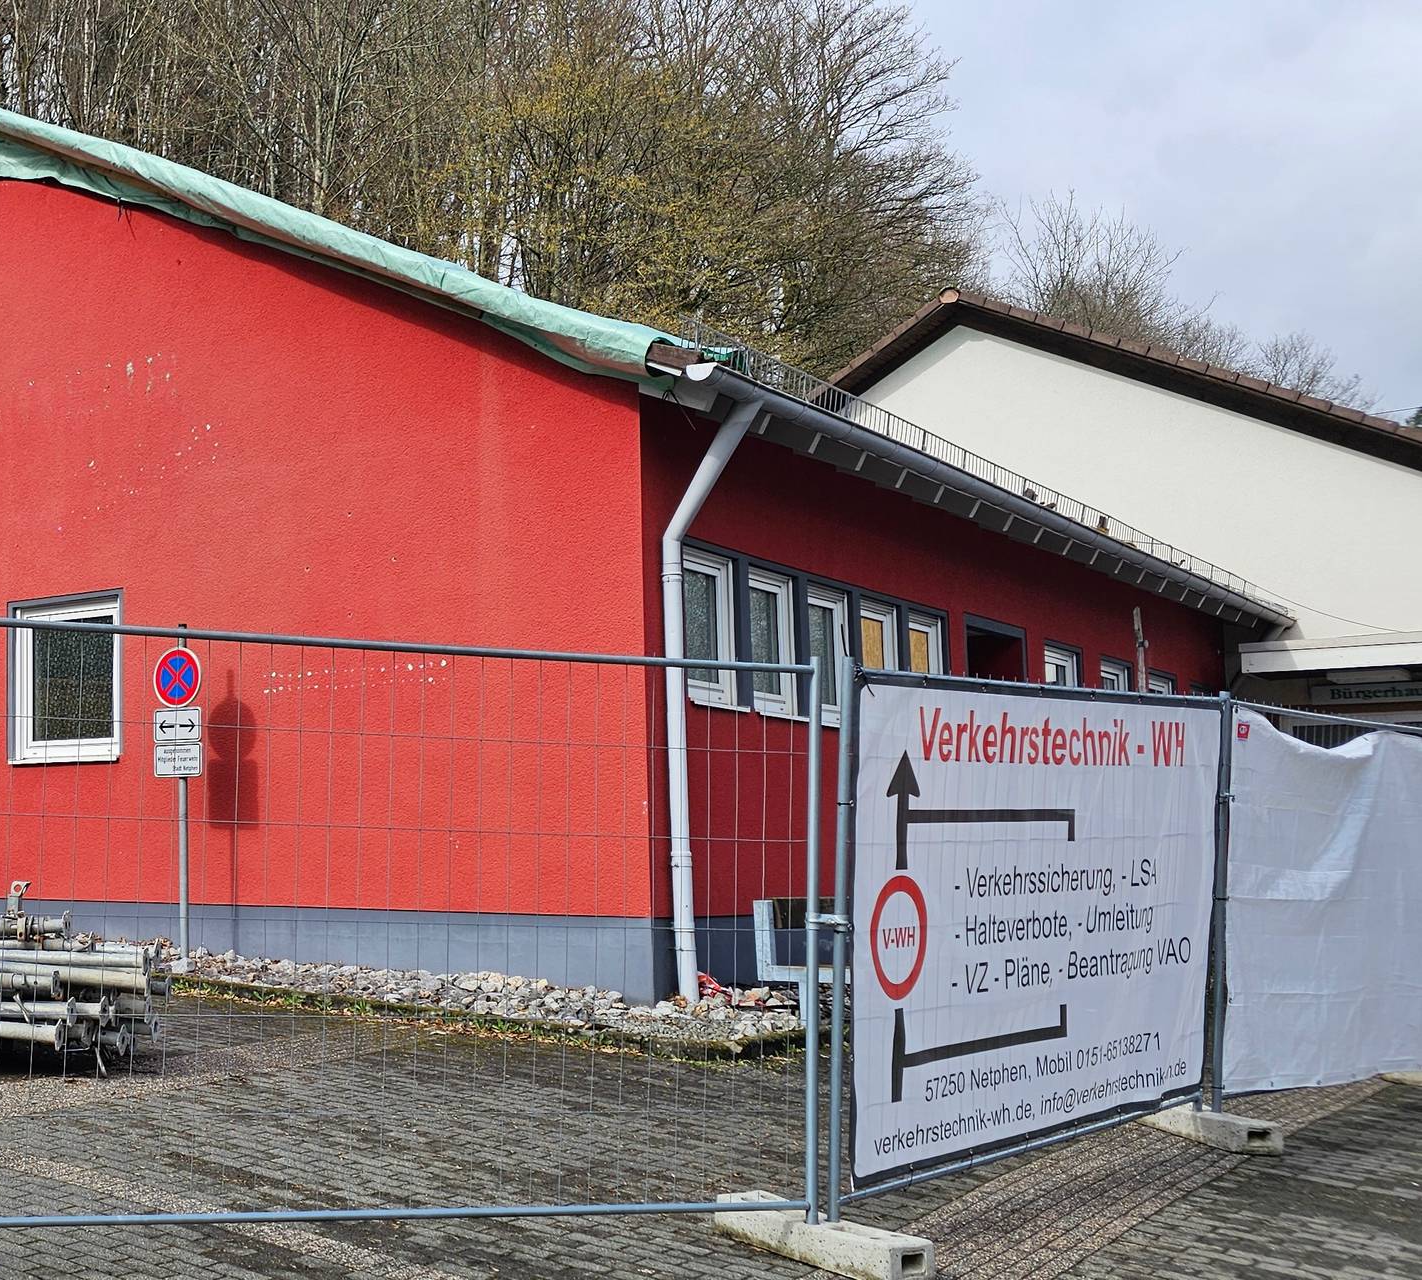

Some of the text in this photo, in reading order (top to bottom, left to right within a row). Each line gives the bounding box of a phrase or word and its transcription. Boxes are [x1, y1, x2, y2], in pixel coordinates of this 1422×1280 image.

[920, 707, 1130, 767] Verkehrstechnik
[1152, 720, 1186, 767] WH
[967, 864, 1116, 899] Verkehrssicherung,
[882, 926, 915, 949] V-WH
[965, 911, 1072, 947] Halteverbote,
[1086, 902, 1153, 934] Umleitung
[965, 961, 989, 994] VZ
[1004, 957, 1053, 989] Pläne,
[1068, 946, 1153, 980] Beantragung
[1157, 937, 1191, 967] VAO
[925, 1031, 1161, 1102] 57250 Netphen, Mobil 0151-65138271
[874, 1099, 1035, 1156] verkehrstechnik-wh.de,
